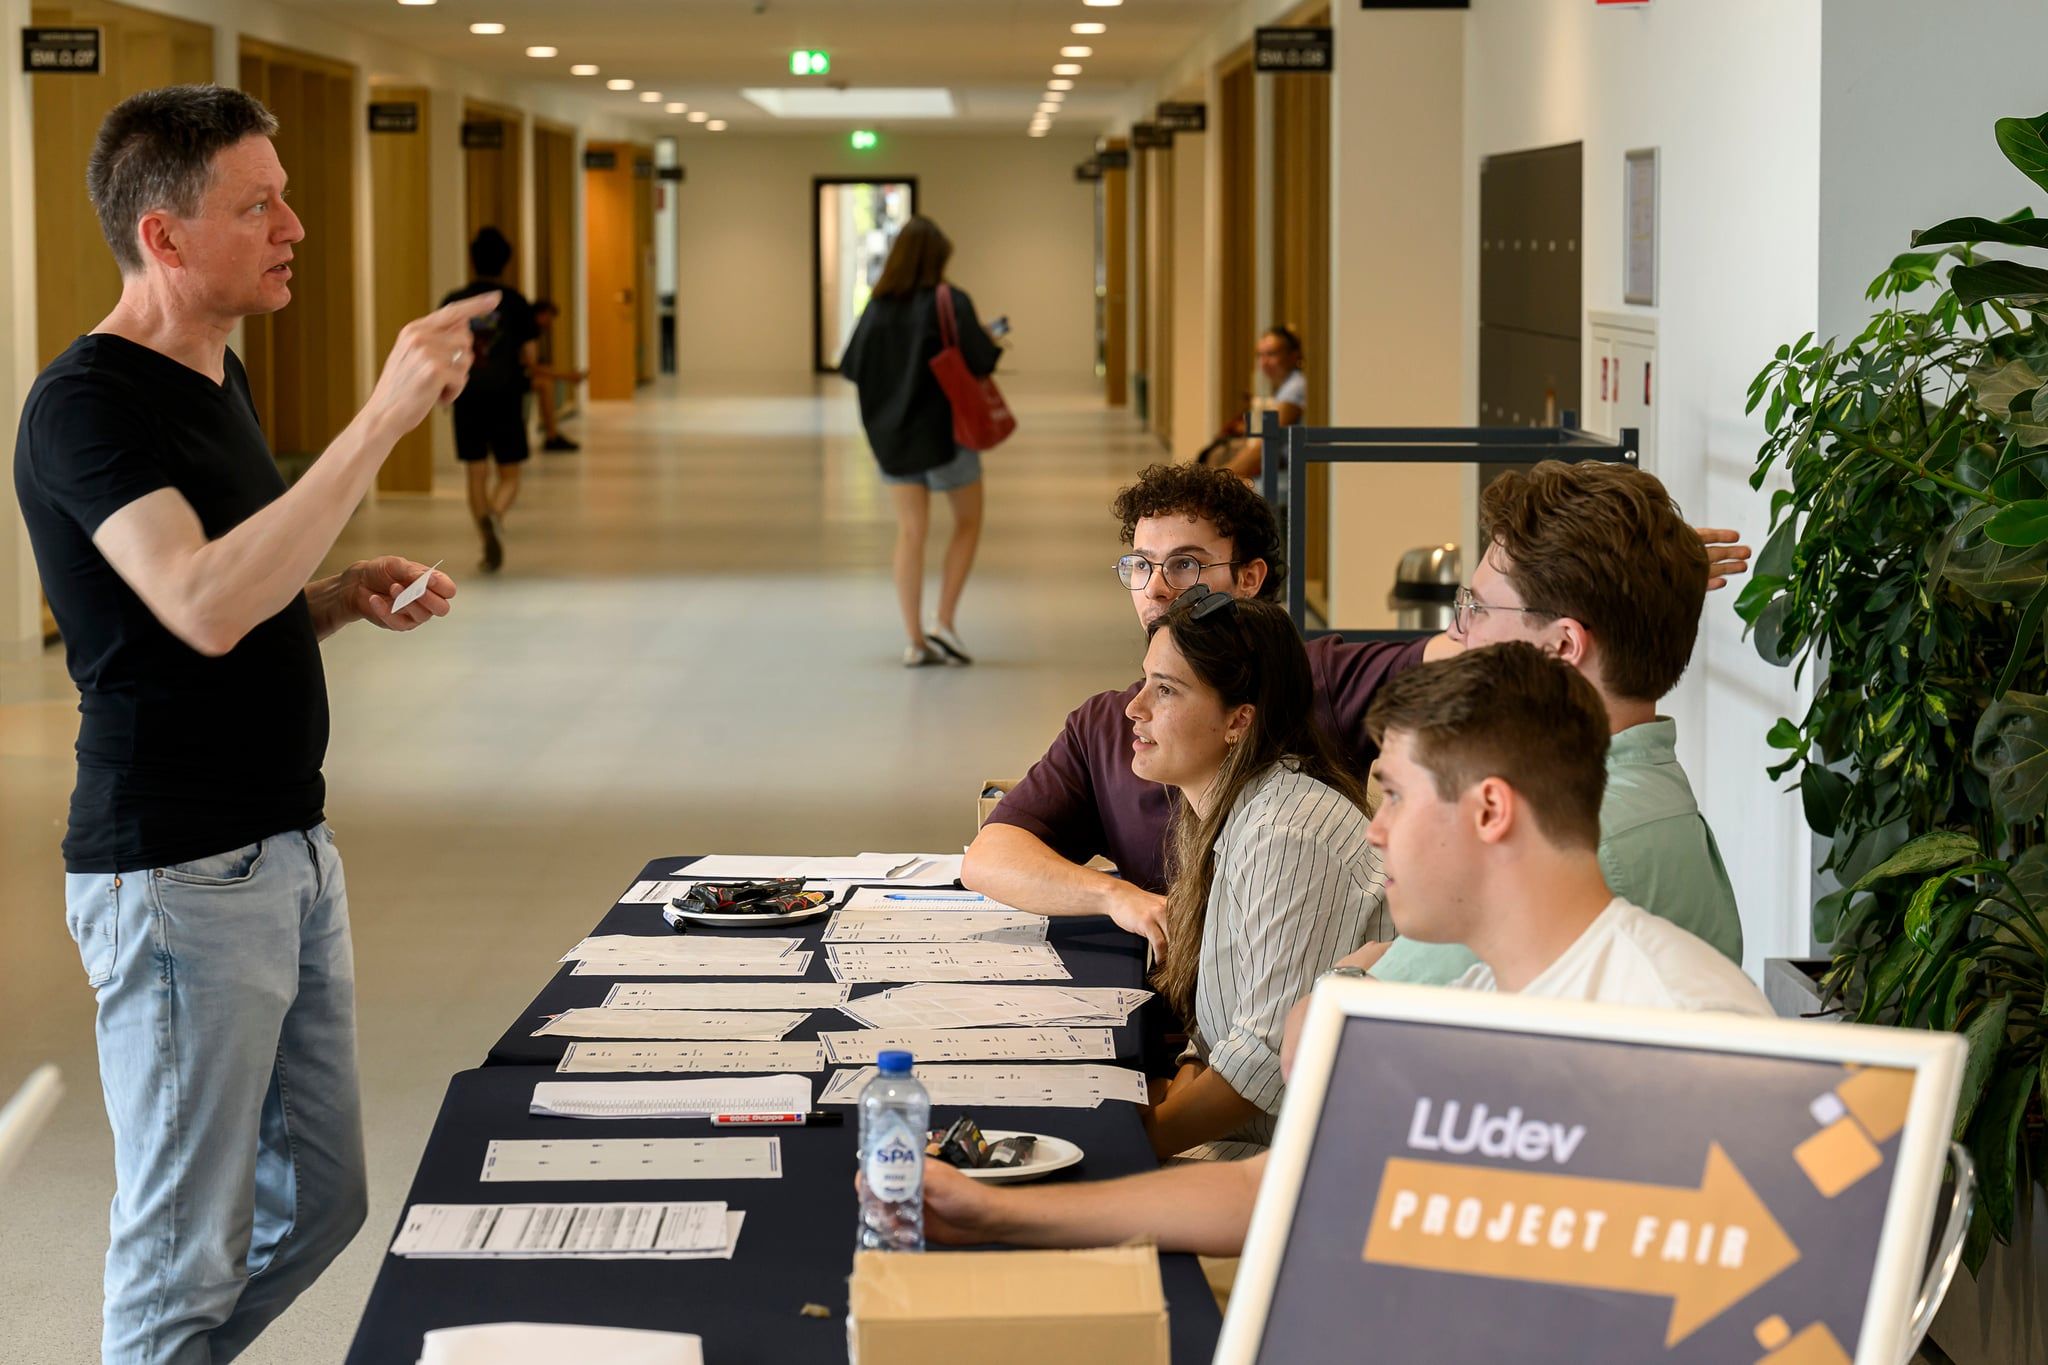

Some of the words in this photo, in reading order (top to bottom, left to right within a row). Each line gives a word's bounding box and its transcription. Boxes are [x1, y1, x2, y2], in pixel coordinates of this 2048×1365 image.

[877, 1148, 915, 1163] SPA
[1408, 1097, 1586, 1163] LUdev
[1389, 1189, 1607, 1253] PROJECT
[1630, 1215, 1749, 1269] FAIR
